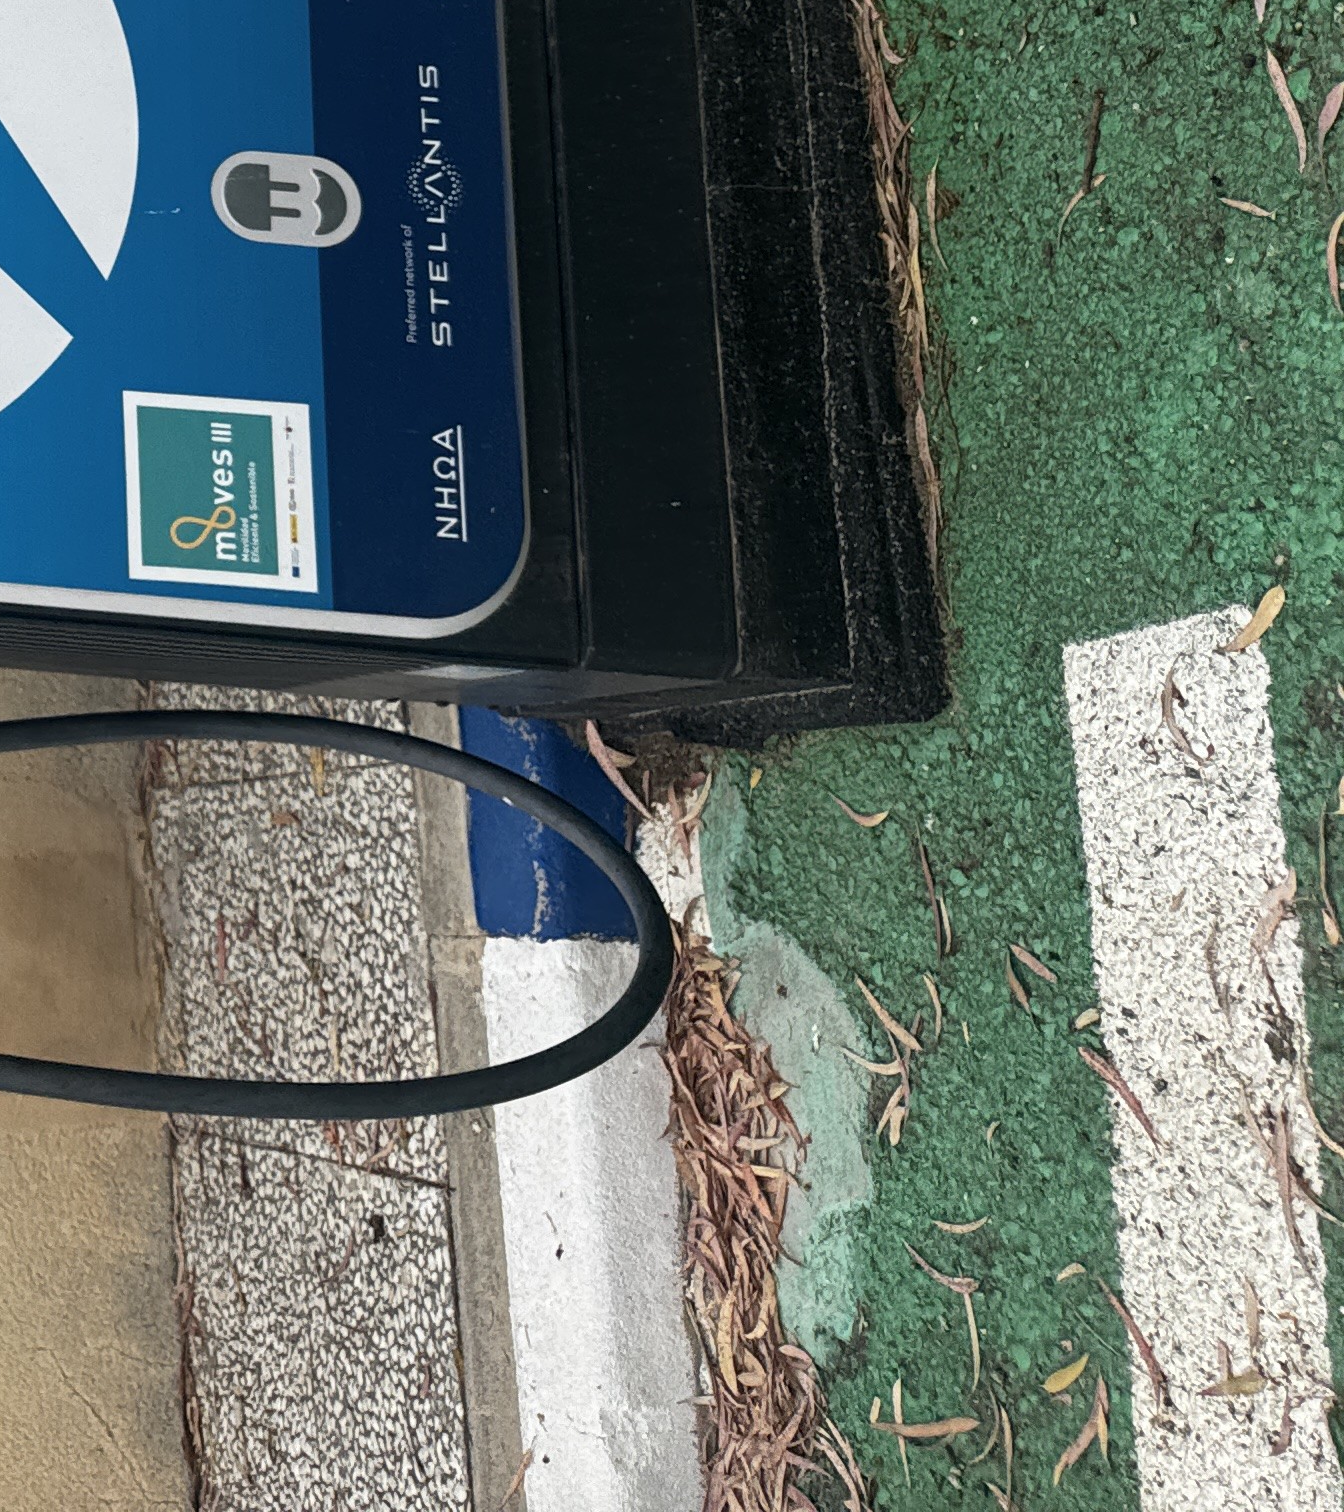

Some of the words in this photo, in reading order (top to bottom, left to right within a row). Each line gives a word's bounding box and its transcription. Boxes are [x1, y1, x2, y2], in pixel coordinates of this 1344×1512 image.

[418, 65, 452, 347] STELLANTIS
[400, 224, 413, 237] of
[402, 239, 416, 286] network
[403, 289, 418, 343] Preferred
[210, 422, 233, 442] III
